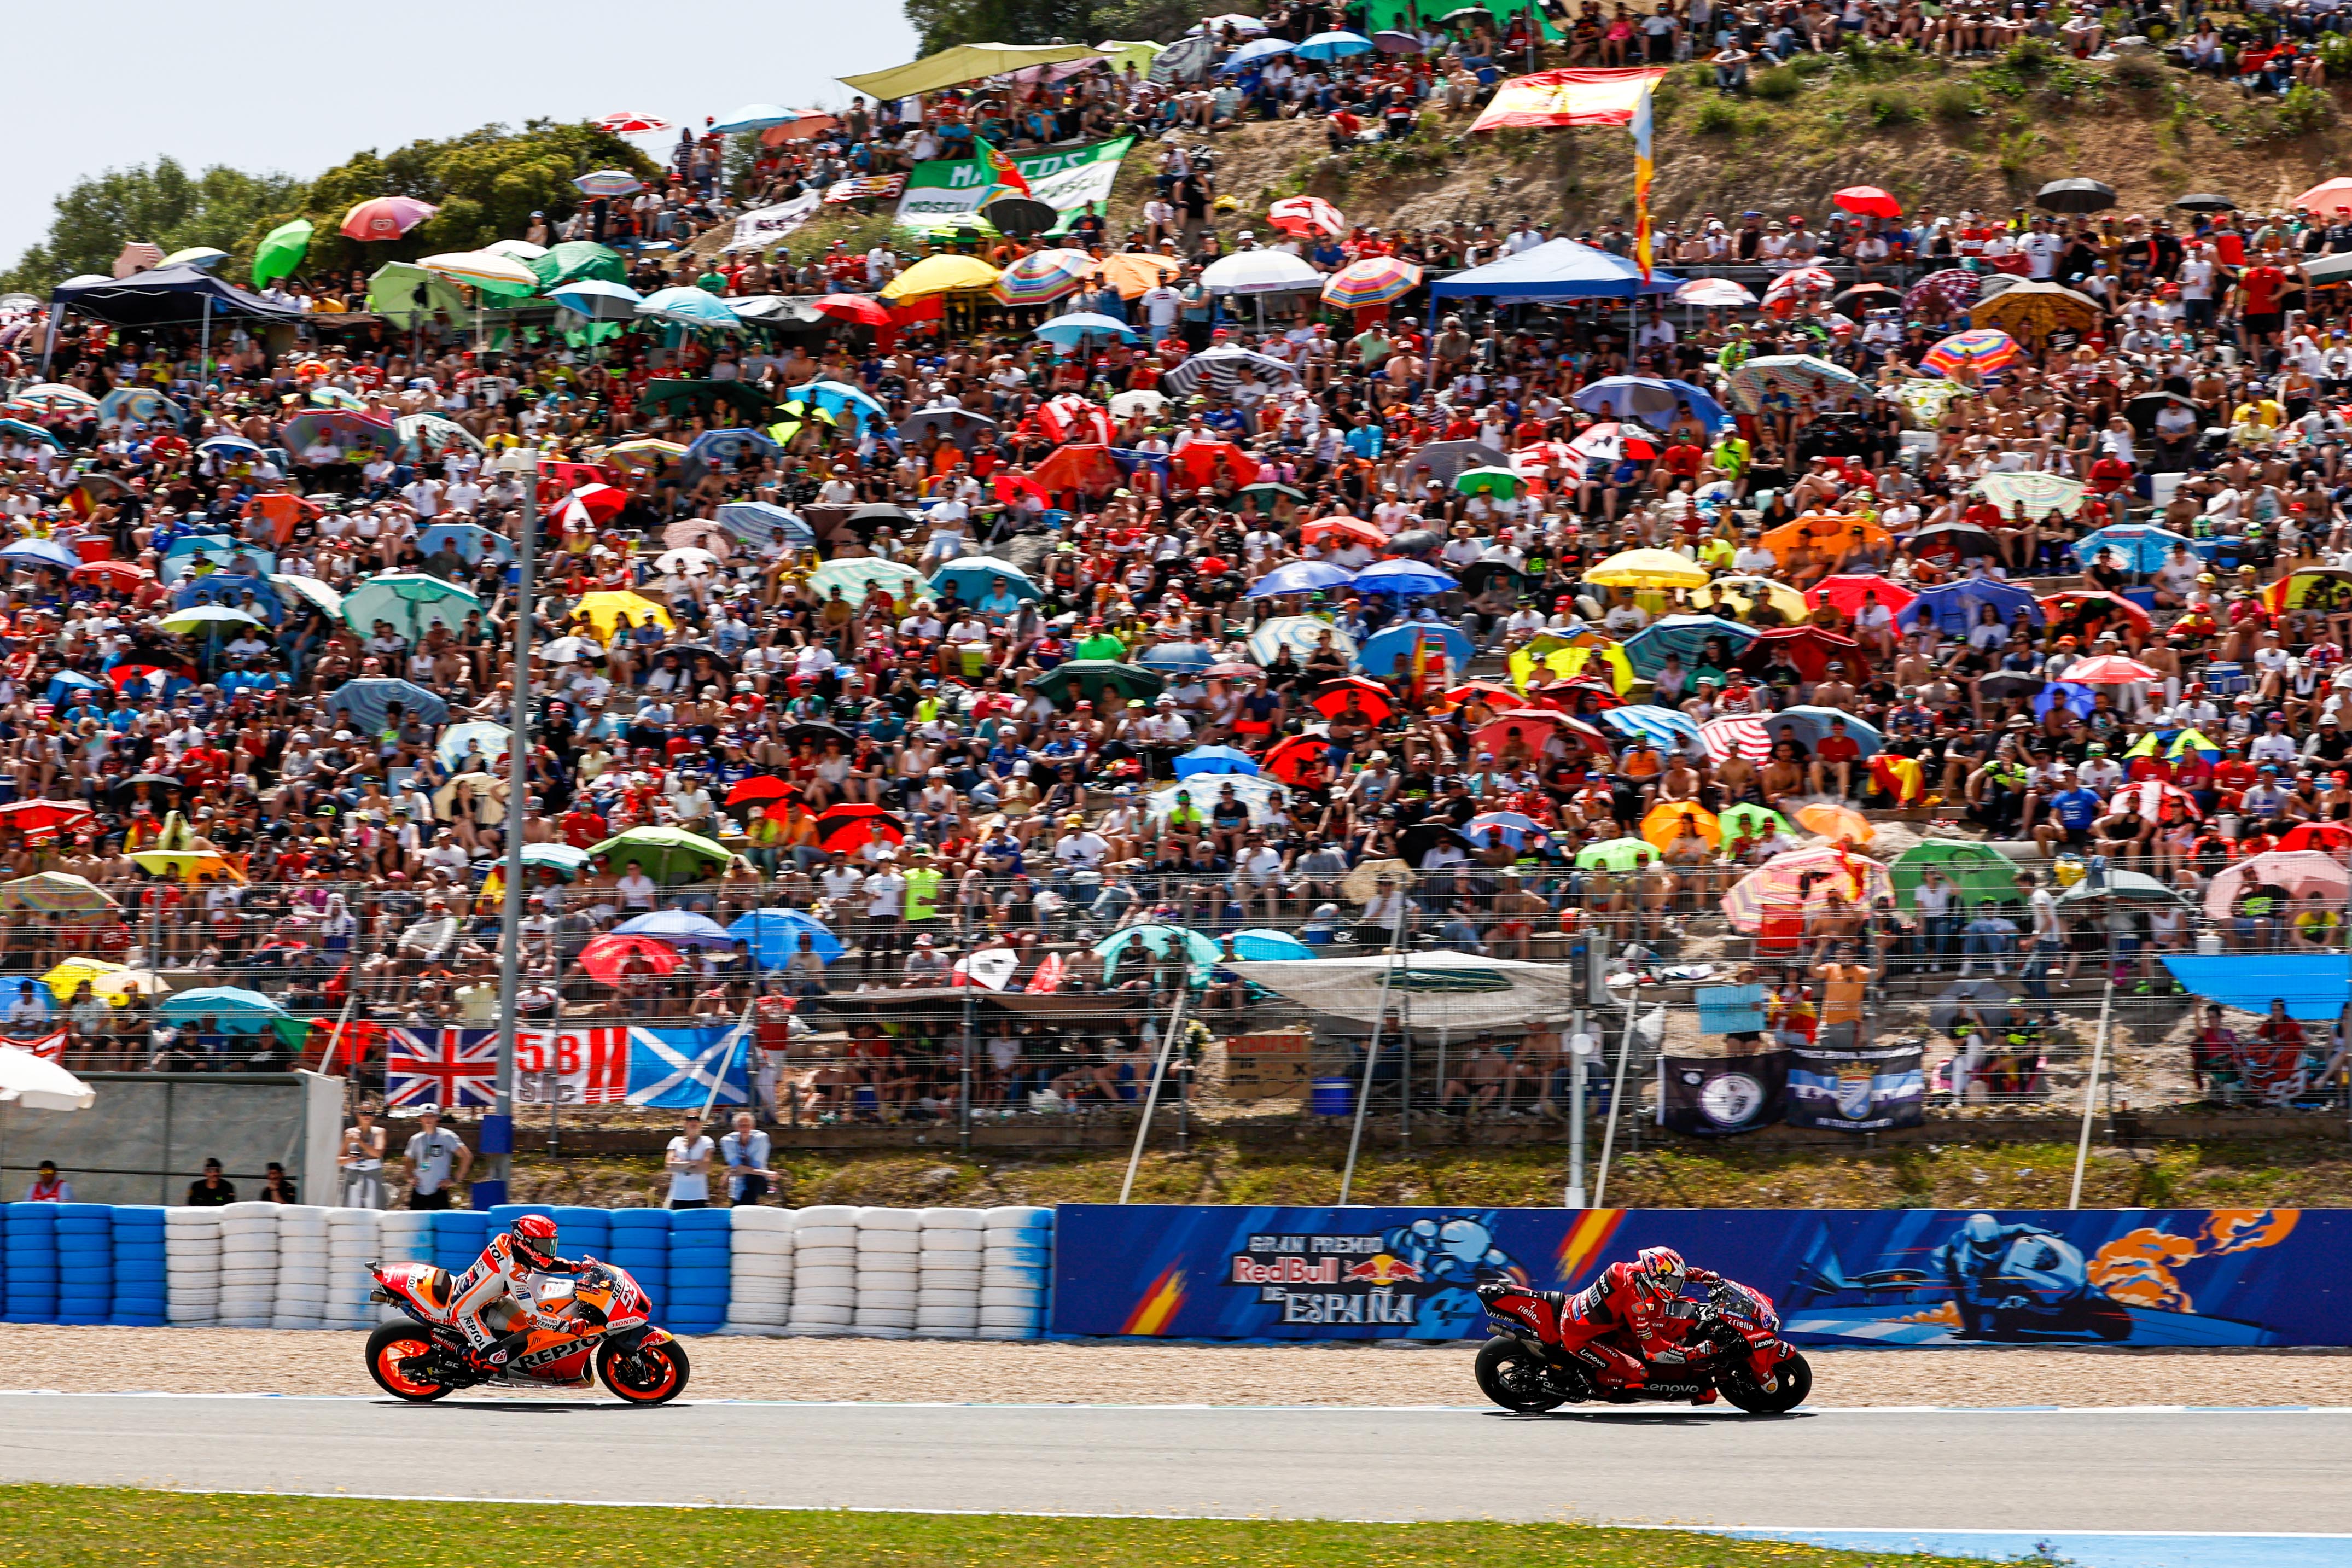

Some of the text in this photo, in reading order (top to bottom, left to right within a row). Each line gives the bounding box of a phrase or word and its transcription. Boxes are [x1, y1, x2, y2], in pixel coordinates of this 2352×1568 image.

[949, 151, 1087, 187] MACOS
[515, 1033, 580, 1075] 58
[1249, 1236, 1384, 1253] GRAN PREMIO
[619, 1278, 638, 1313] 93
[1283, 1287, 1417, 1322] ESPAÑA
[424, 1313, 441, 1323] One
[1517, 1305, 1537, 1320] riello
[612, 1317, 639, 1328] HONDA
[1733, 1319, 1754, 1331] riello
[464, 1316, 486, 1349] REPSOL
[516, 1331, 610, 1369] REPSOL
[1754, 1338, 1774, 1349] Lenovo
[444, 1360, 460, 1369] SC
[1579, 1348, 1606, 1368] Lenovo
